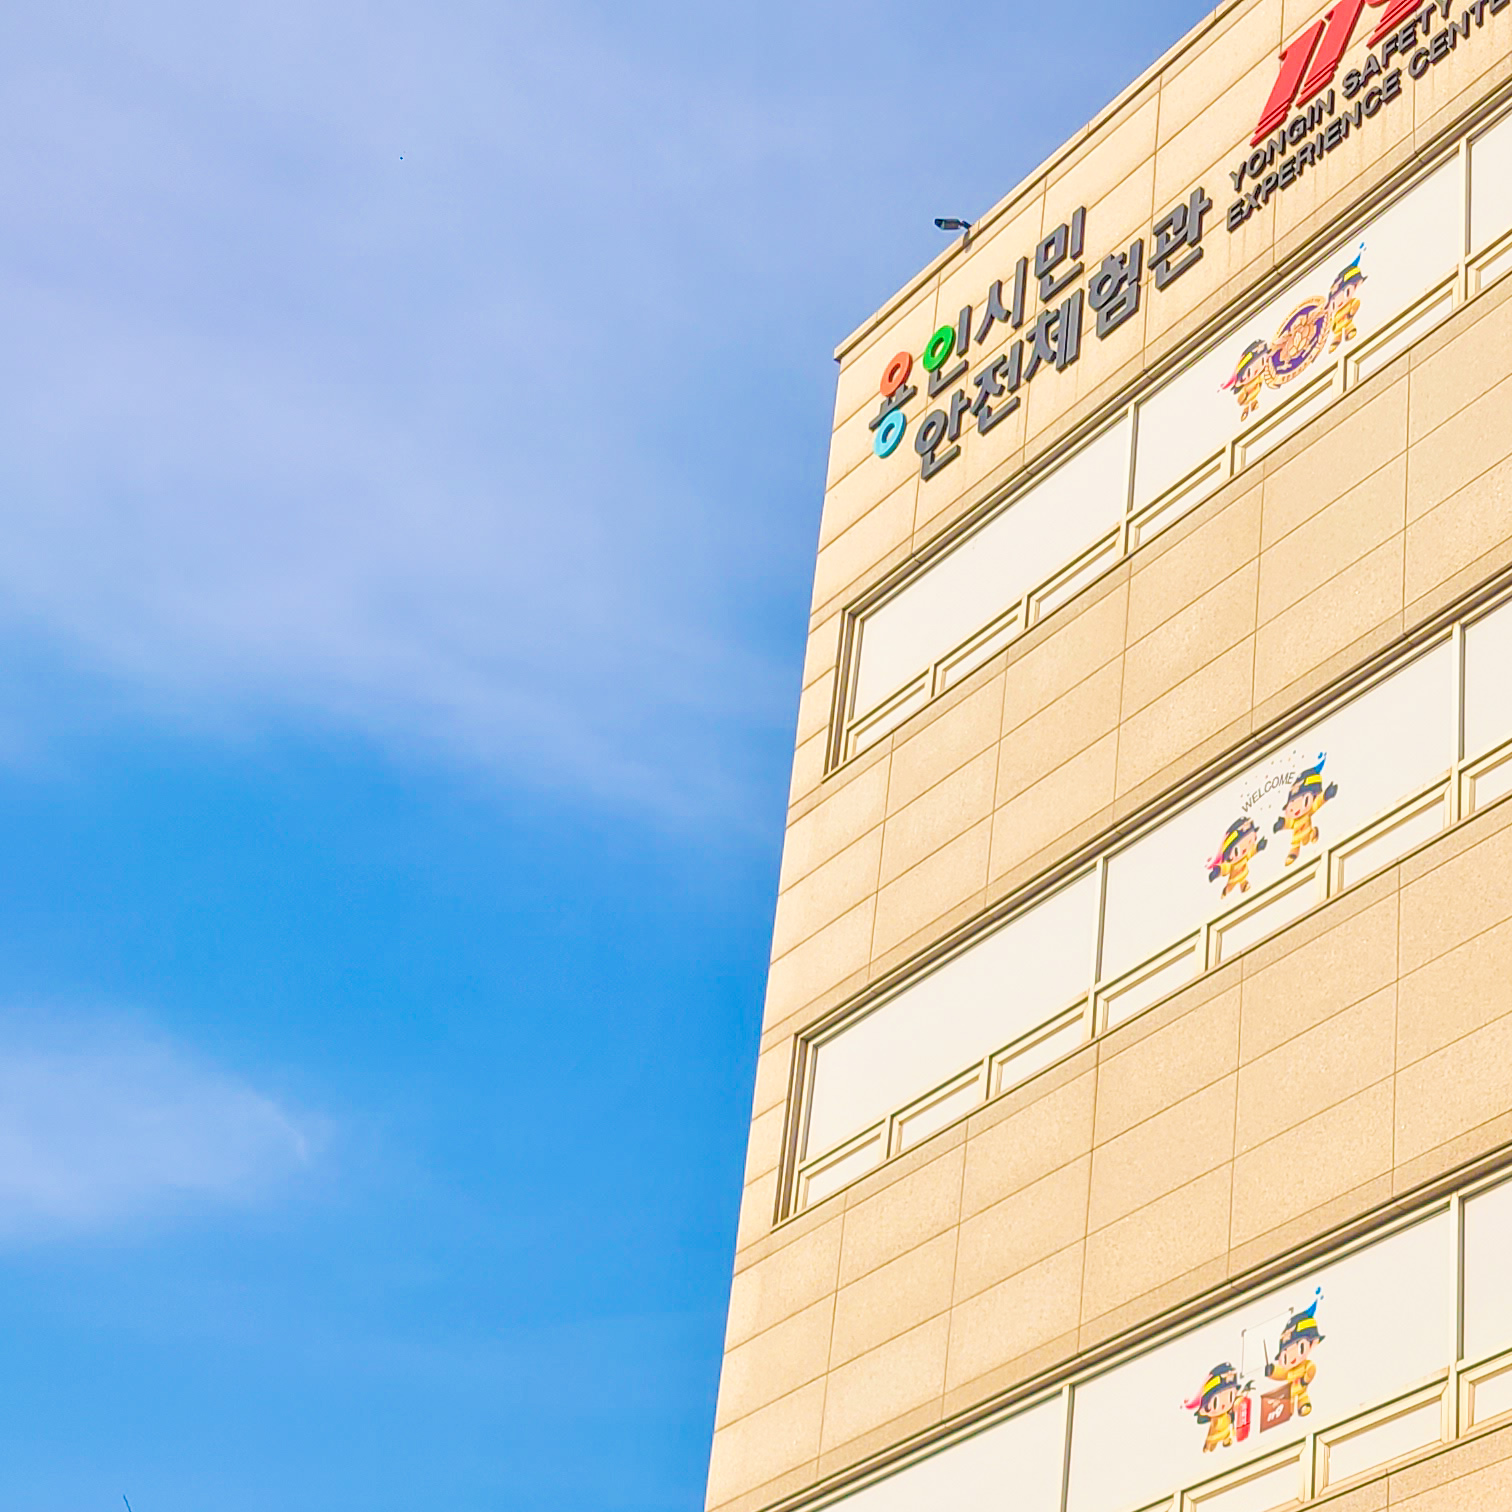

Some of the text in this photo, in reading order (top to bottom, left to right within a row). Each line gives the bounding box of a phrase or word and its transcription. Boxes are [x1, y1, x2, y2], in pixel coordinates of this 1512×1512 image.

[1226, 69, 1402, 232] EXPERIENCE
[1229, 0, 1450, 191] YONGIN SAFETY
[869, 206, 1086, 458] 용인시민
[915, 186, 1212, 481] 안전체험관
[1241, 772, 1296, 812] WELCOME
